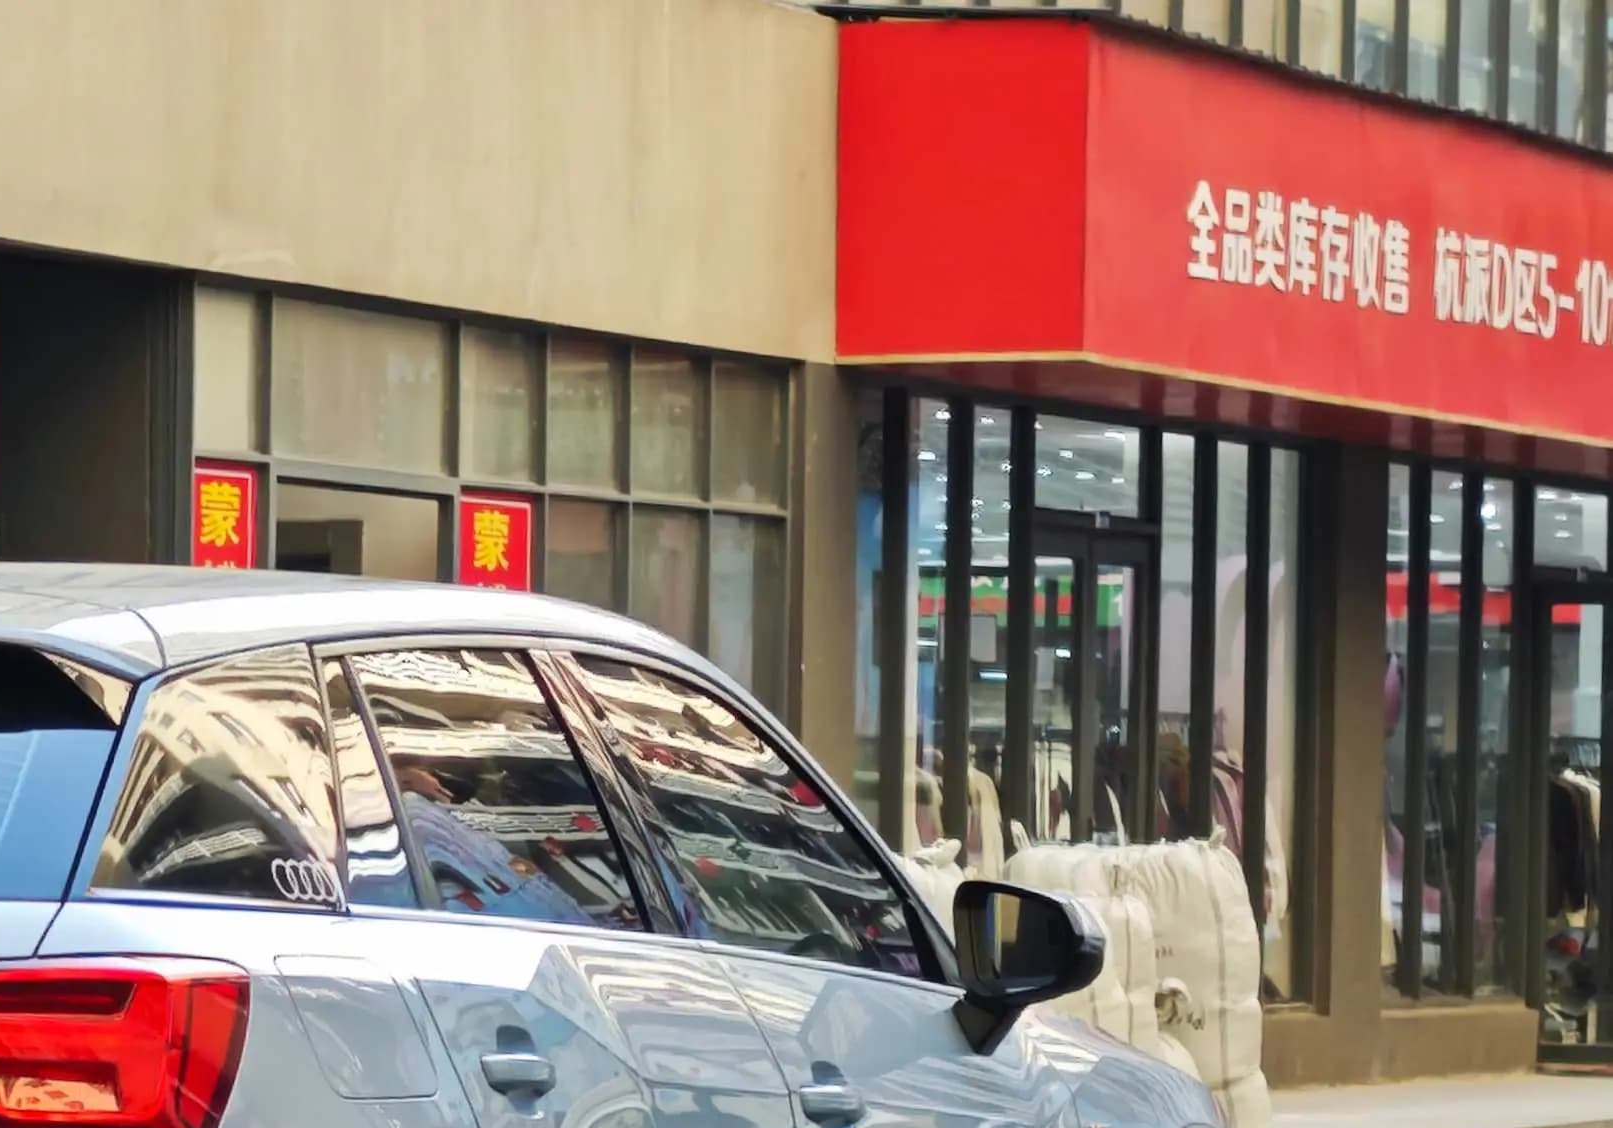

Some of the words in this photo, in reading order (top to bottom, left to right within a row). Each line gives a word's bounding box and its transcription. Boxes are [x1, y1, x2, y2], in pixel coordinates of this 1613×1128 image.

[1187, 179, 1410, 316] 全品类库存收售
[199, 480, 241, 547] 蒙
[473, 509, 509, 572] 蒙
